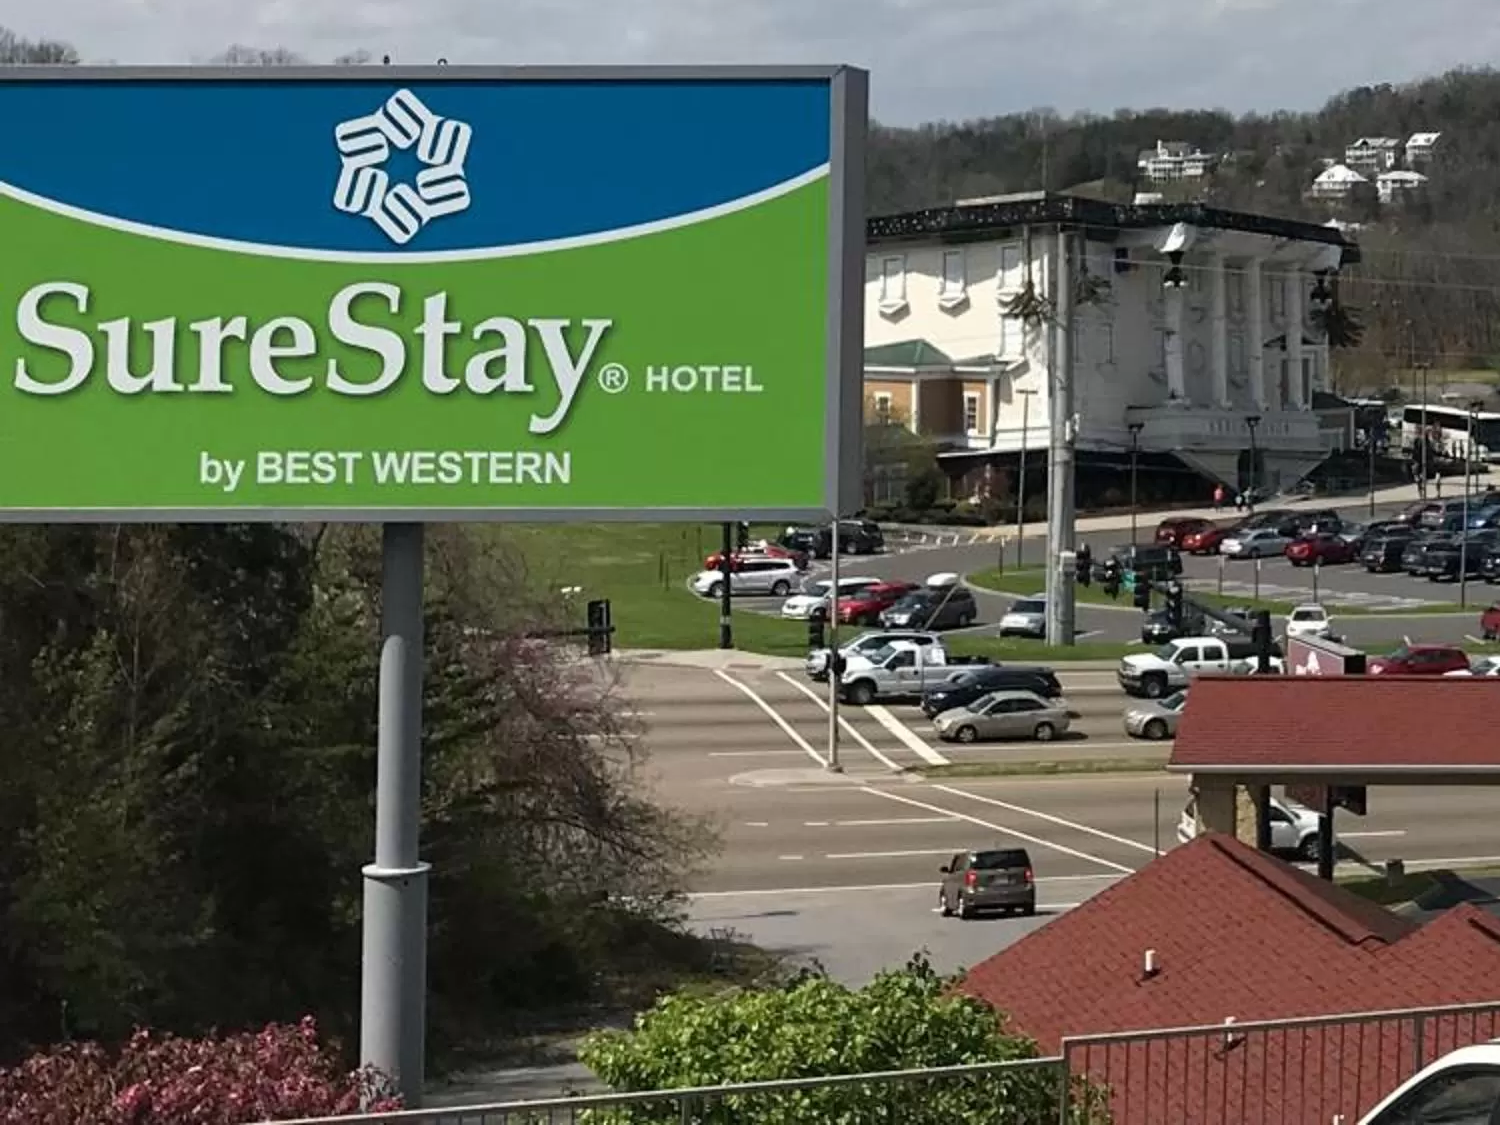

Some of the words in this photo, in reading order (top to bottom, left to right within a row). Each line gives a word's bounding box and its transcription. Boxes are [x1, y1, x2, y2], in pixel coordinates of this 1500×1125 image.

[13, 281, 613, 434] SureStay
[645, 365, 764, 393] HOTEL
[200, 451, 246, 492] by
[256, 451, 362, 484] BEST
[371, 451, 571, 484] WESTERN
